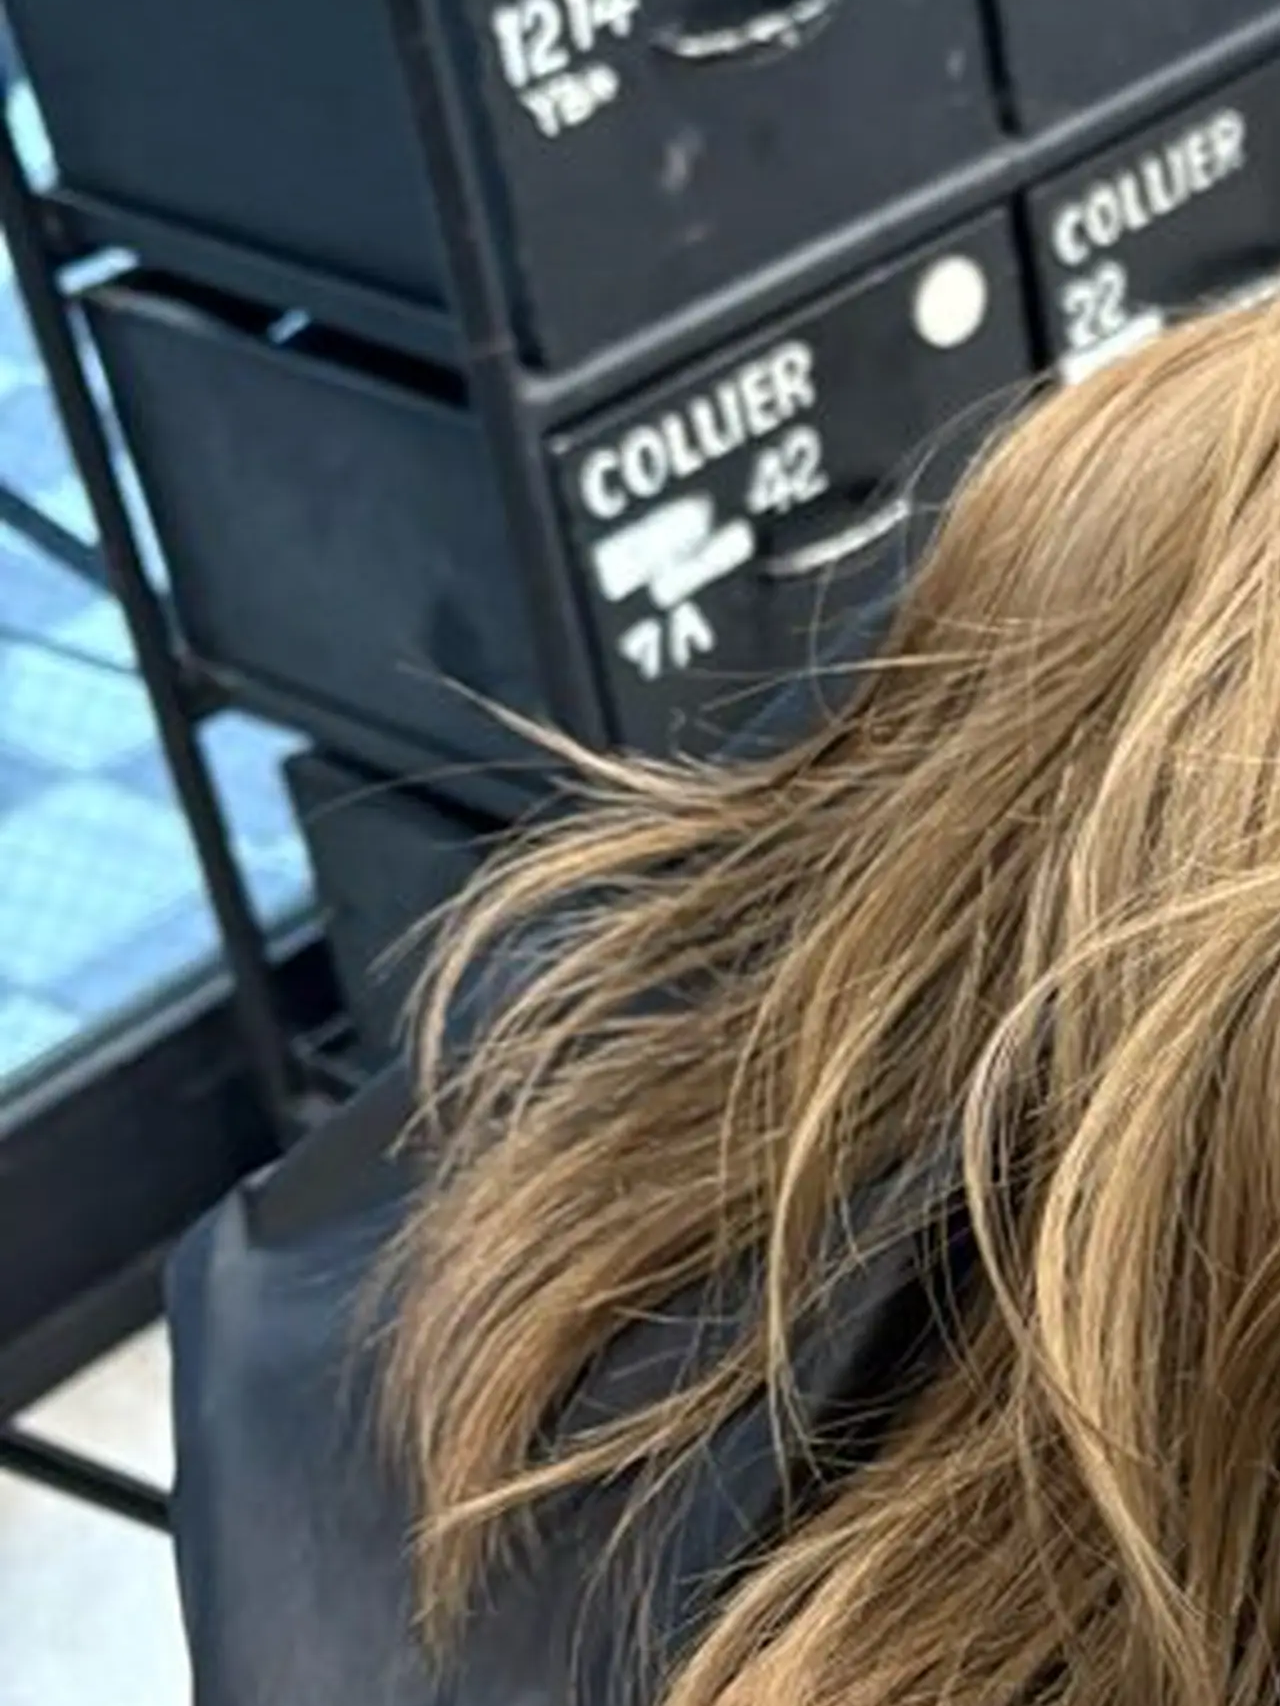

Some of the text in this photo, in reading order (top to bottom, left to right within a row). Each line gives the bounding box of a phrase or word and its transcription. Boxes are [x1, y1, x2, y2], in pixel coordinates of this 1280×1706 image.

[1055, 107, 1246, 265] COLLIER
[1064, 261, 1127, 347] 22
[581, 340, 815, 519] COLLIER
[746, 426, 830, 515] 42
